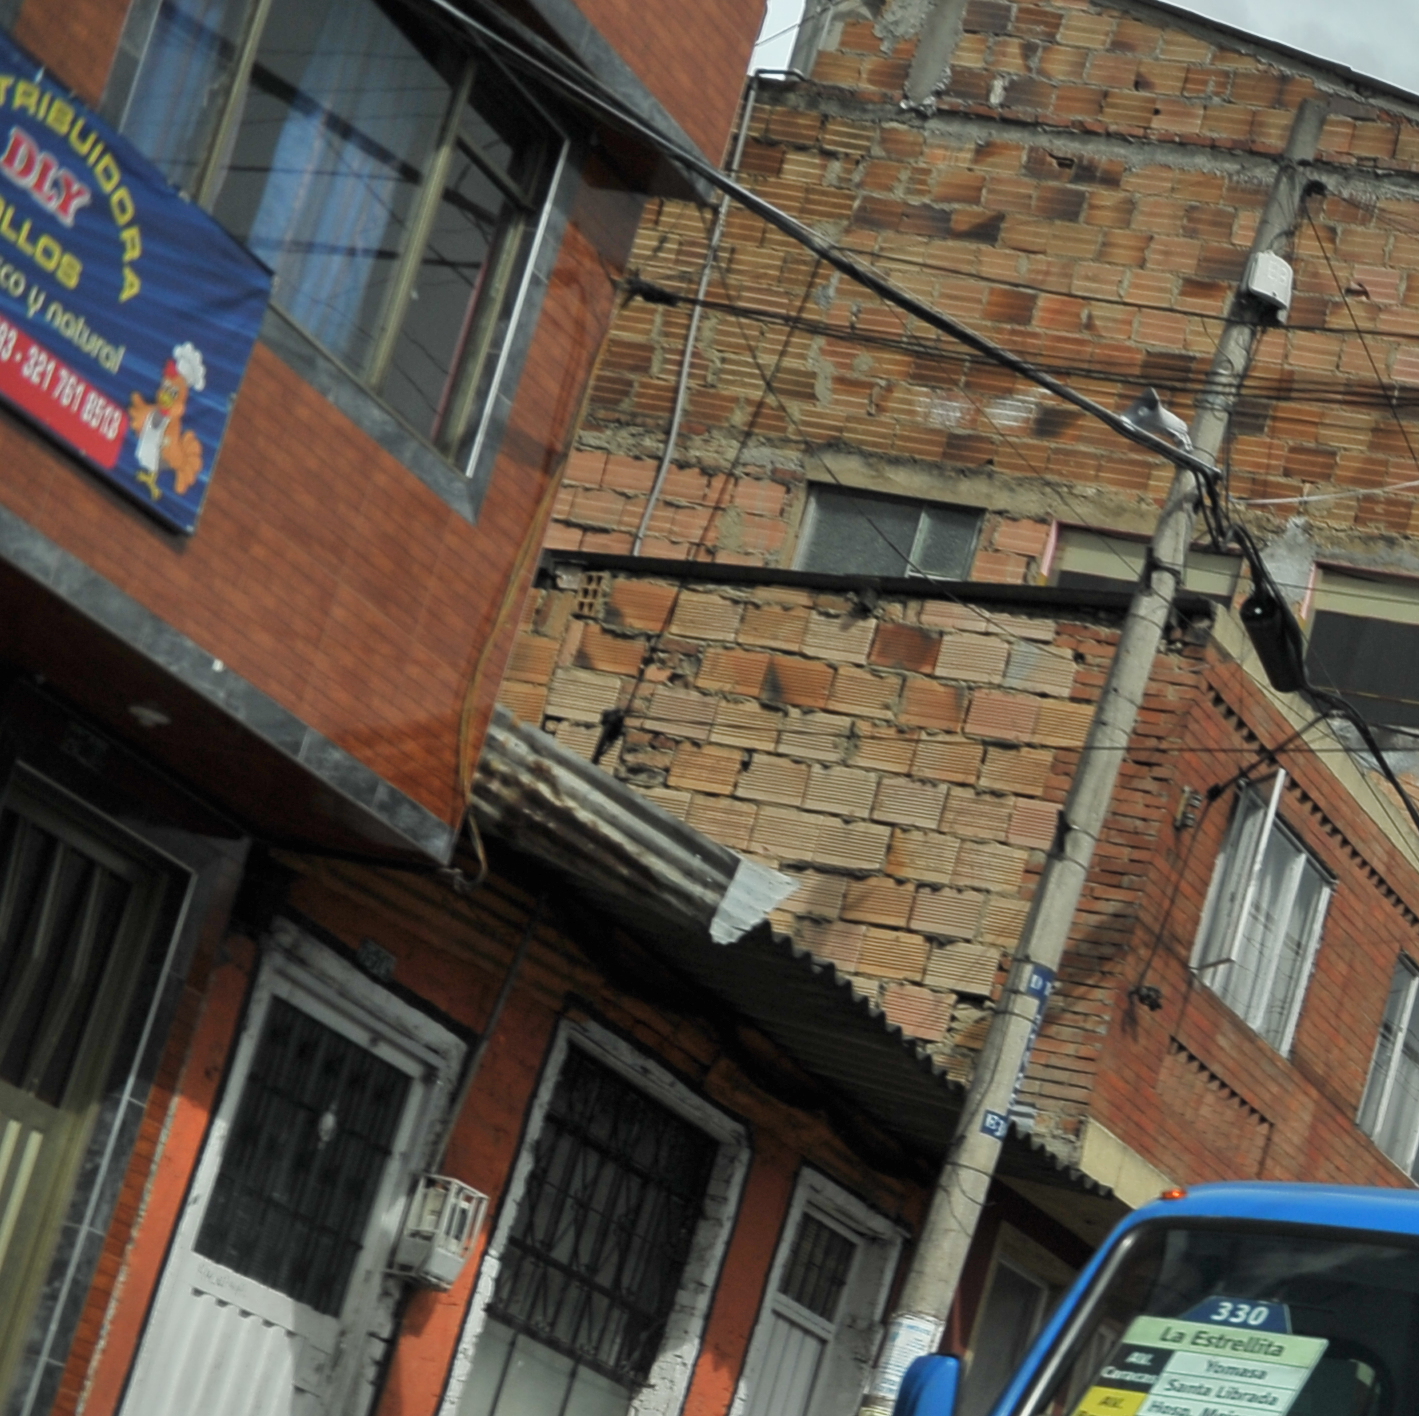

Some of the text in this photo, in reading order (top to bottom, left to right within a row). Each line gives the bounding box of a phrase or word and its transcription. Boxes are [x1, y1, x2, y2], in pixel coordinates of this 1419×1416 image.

[0, 255, 126, 374] co y natural
[22, 345, 56, 391] 321
[52, 368, 86, 413] 761
[1211, 1302, 1270, 1325] 330
[1160, 1326, 1285, 1357] La Estrellita
[1205, 1359, 1268, 1380] Yomasa
[1163, 1378, 1279, 1406] Santa Librada
